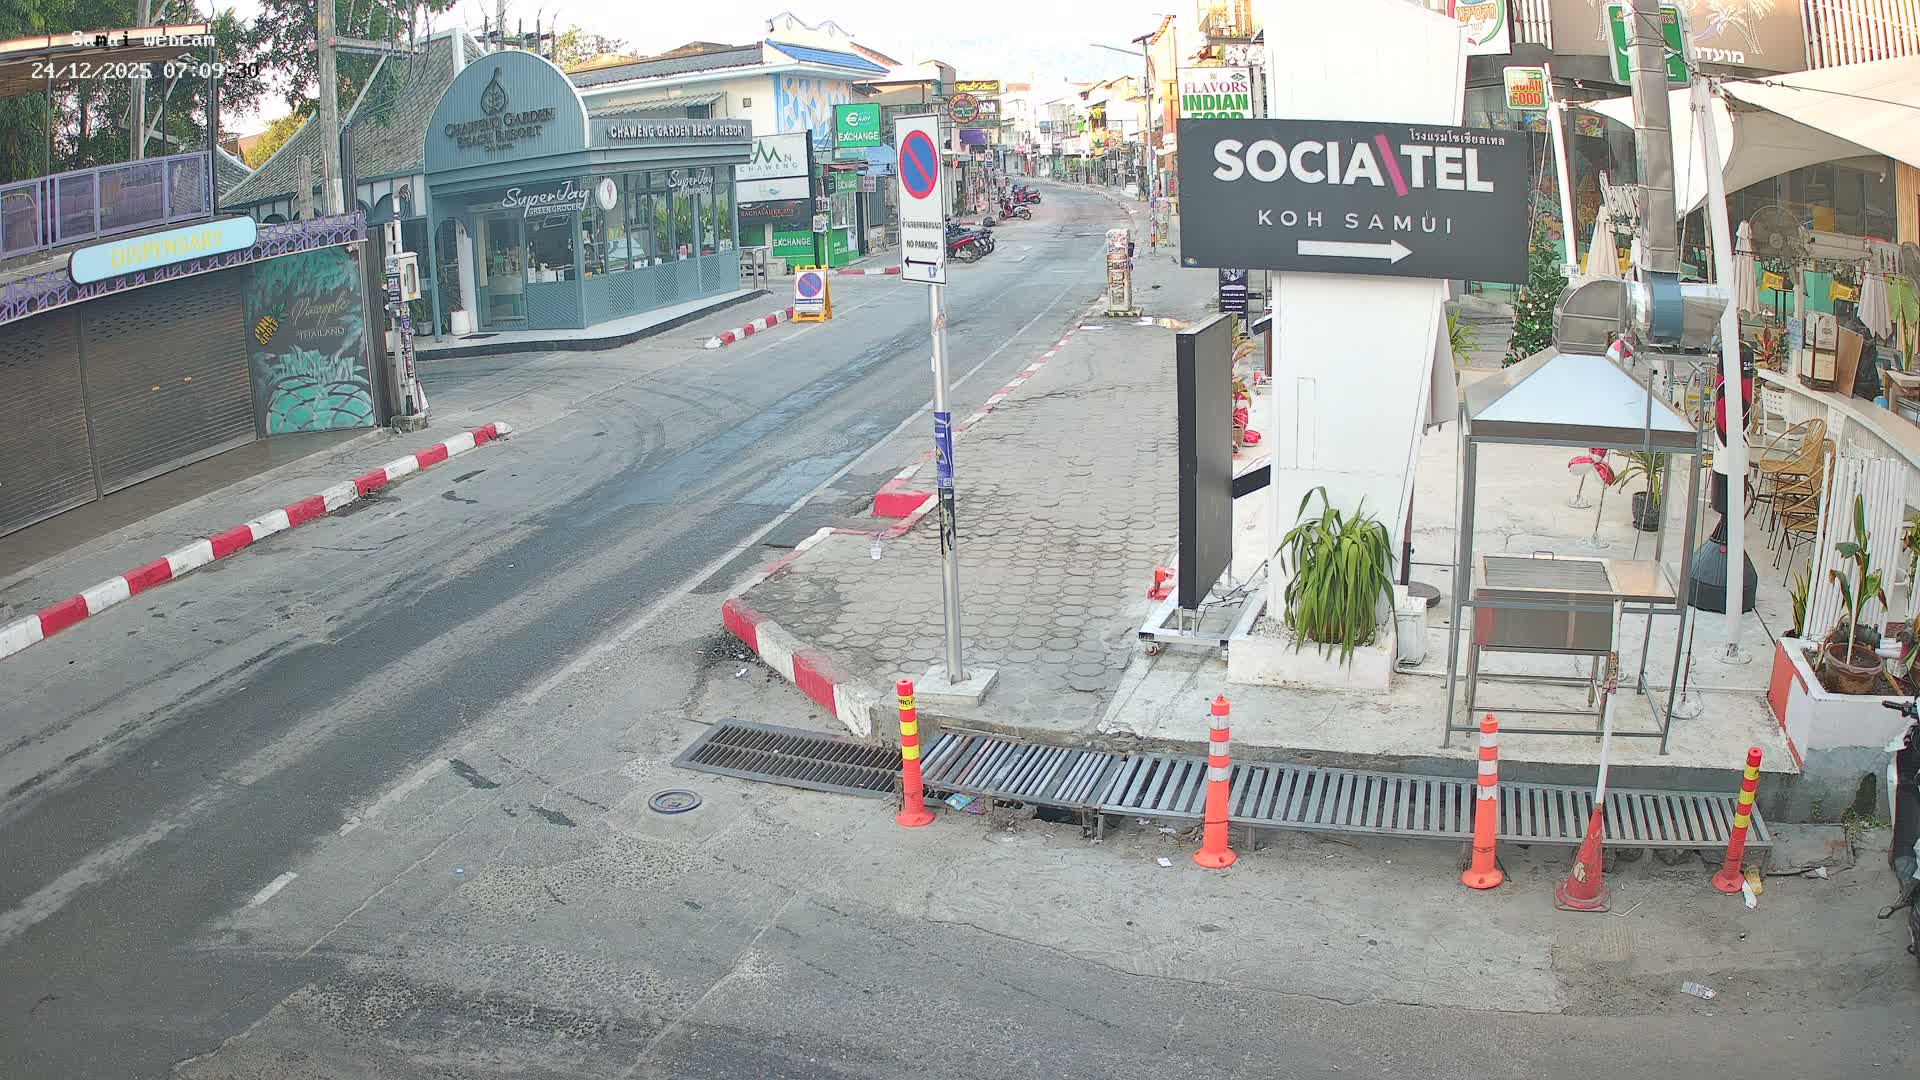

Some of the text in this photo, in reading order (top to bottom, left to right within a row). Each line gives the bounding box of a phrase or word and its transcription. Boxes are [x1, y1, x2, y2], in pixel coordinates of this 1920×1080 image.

[1184, 82, 1248, 93] FLAVORS
[1183, 94, 1248, 111] INDIAN
[1513, 92, 1542, 105] FOOD
[503, 108, 556, 126] GARDEN
[496, 126, 543, 141] RESORT
[611, 125, 746, 137] CHAWENG GARDEN BEACH RESORT
[838, 131, 879, 141] EXCHANGE
[740, 163, 798, 173] CHAWENG
[1258, 209, 1451, 234] KOH SAMUI
[774, 237, 811, 247] EXCHANGE
[906, 240, 938, 250] NO PARKING
[112, 228, 223, 270] DISPENSARY
[299, 327, 345, 340] THAILAND
